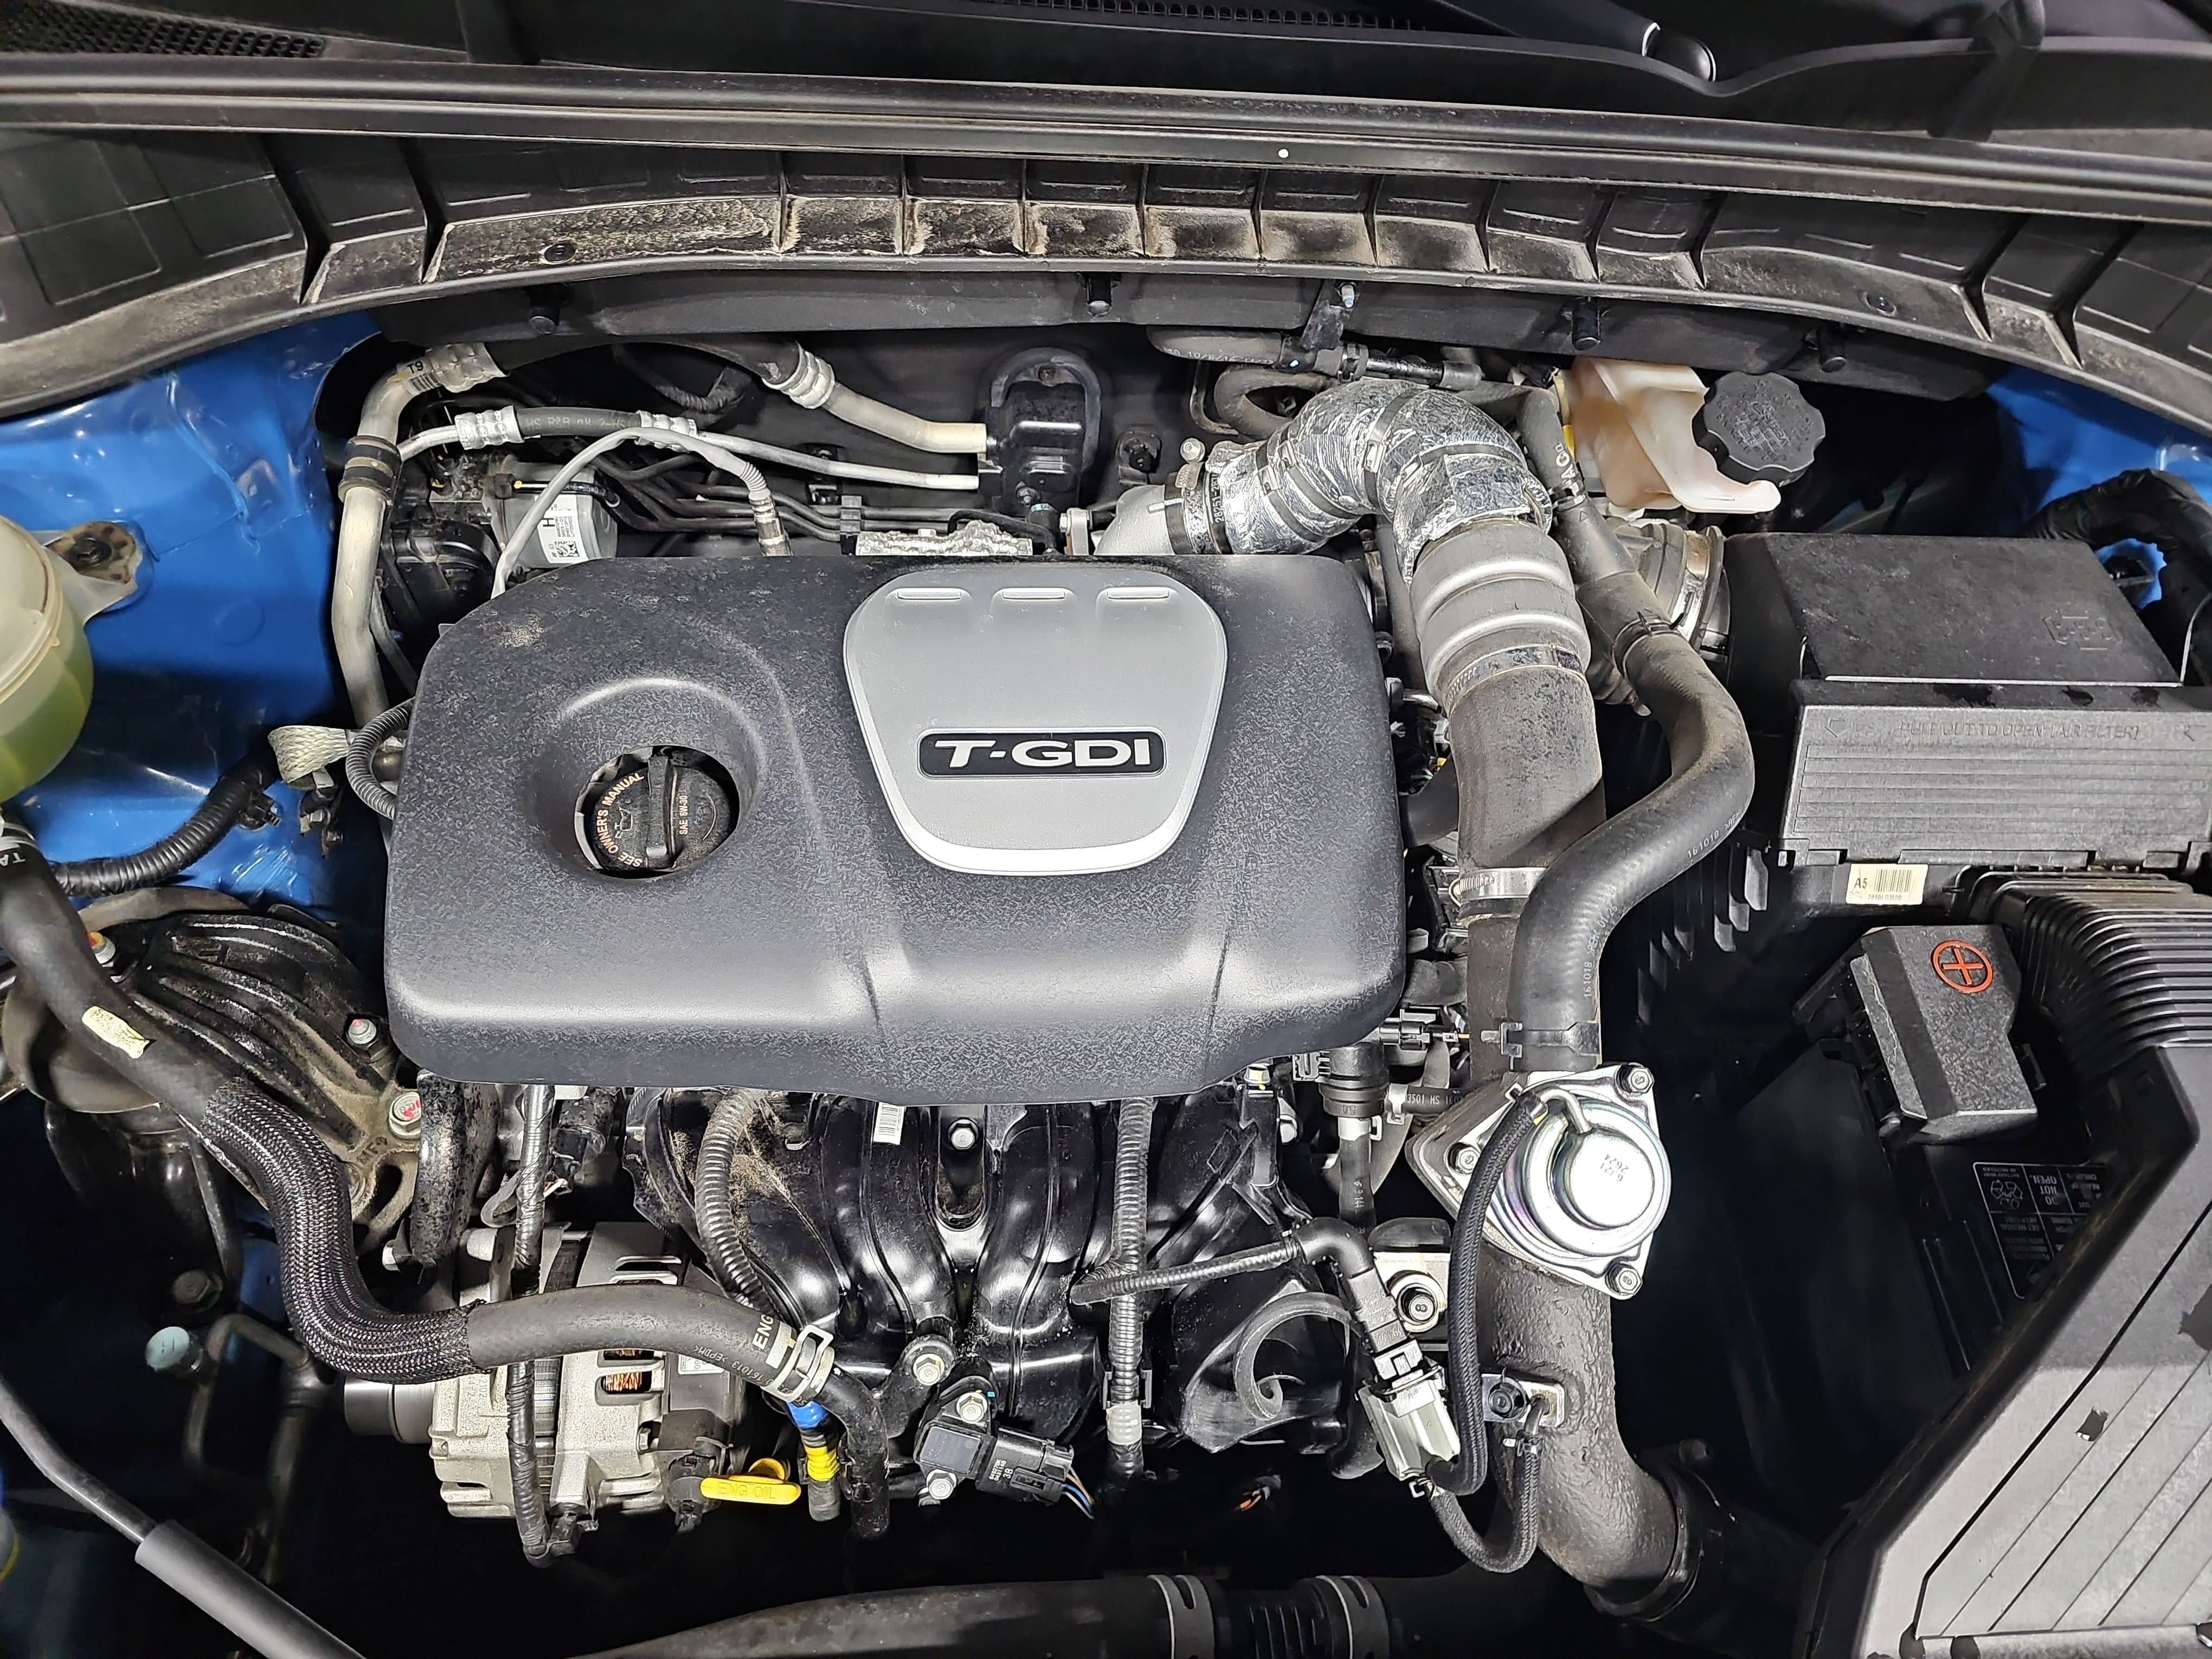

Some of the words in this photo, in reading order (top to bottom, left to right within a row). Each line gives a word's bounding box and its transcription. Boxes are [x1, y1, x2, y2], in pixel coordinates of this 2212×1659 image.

[406, 360, 424, 375] T9
[1978, 723, 1998, 736] TO
[2002, 723, 2044, 738] OPEN
[935, 738, 1150, 768] T-GDI
[602, 772, 645, 807] MANUAL
[679, 795, 688, 818] 5W-30
[596, 809, 620, 854] OWNER'S
[679, 819, 688, 835] SAE
[617, 852, 644, 867] SEE
[1854, 877, 1868, 889] A5
[1430, 1095, 1440, 1105] HS
[2040, 1185, 2057, 1195] NOT
[752, 1314, 774, 1351] ENG
[1002, 1467, 1013, 1479] 3B
[717, 1482, 748, 1498] ENG
[752, 1486, 776, 1500] OIL
